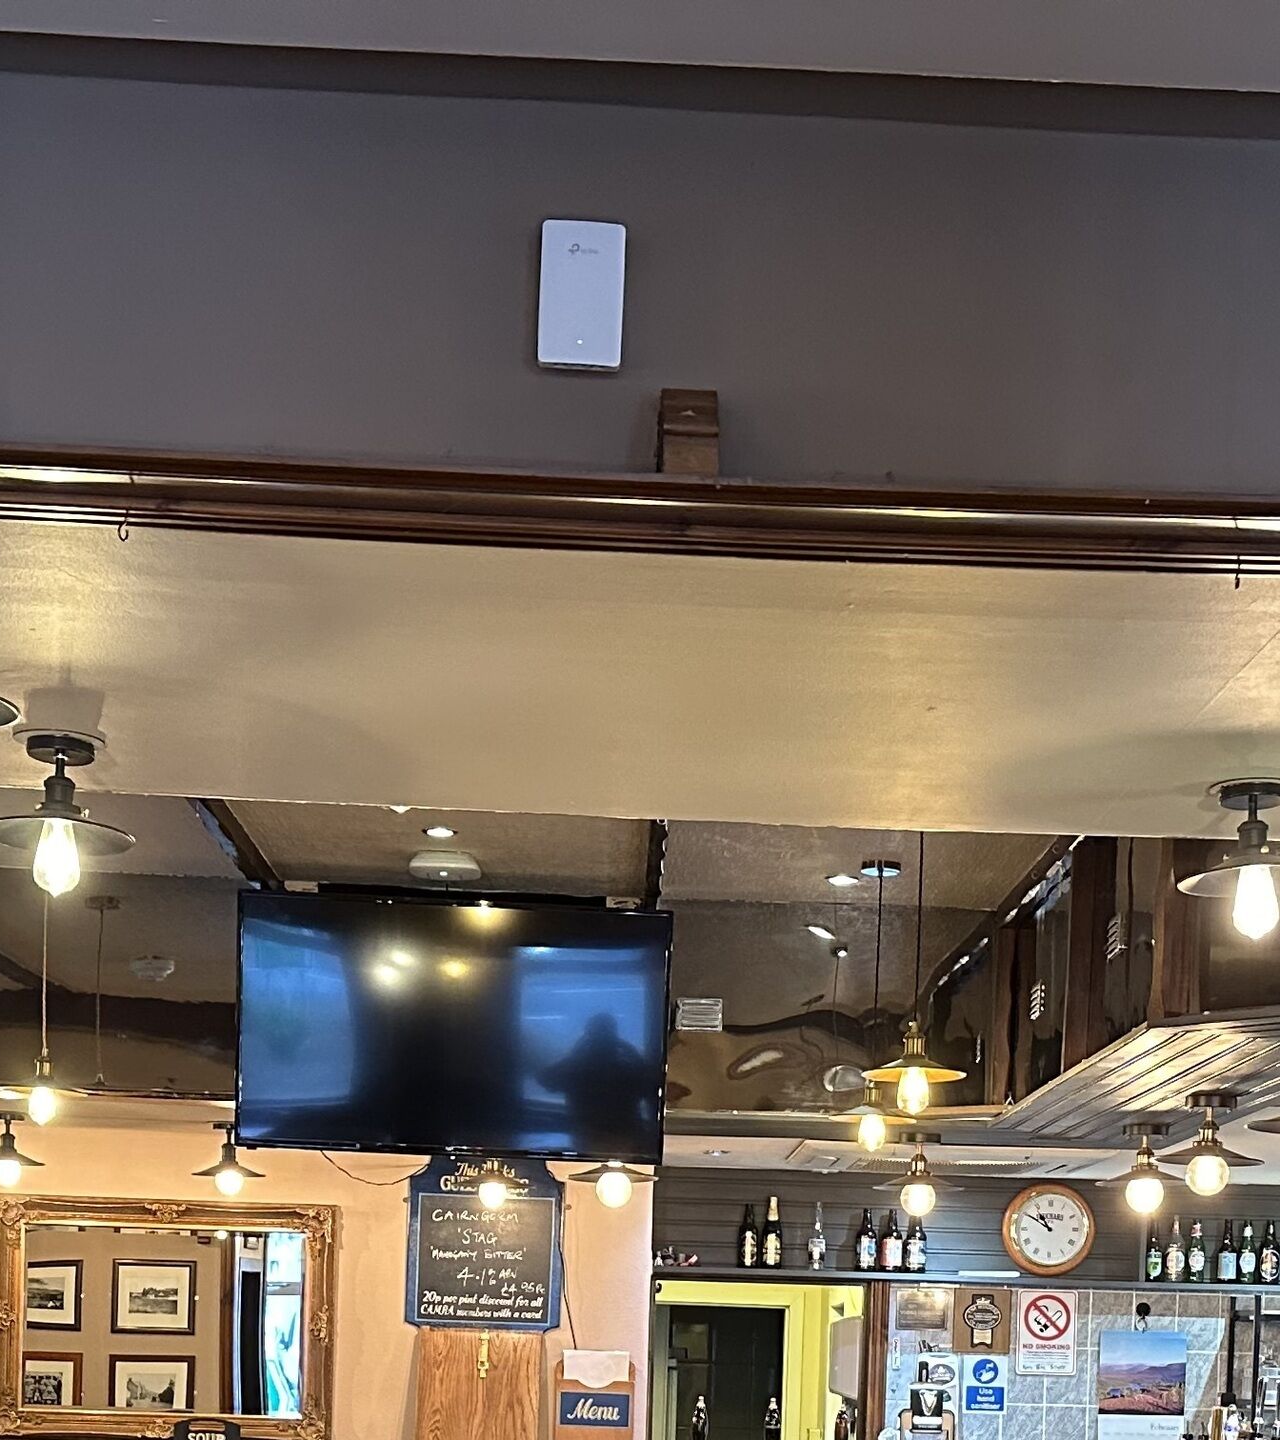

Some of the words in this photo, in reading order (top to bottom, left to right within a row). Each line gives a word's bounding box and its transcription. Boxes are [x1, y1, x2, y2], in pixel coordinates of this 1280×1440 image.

[432, 1208, 519, 1223] CAIRNGORM
[422, 1290, 442, 1304] 20p
[442, 1296, 458, 1305] per
[458, 1293, 478, 1306] pint
[478, 1293, 514, 1307] discount
[514, 1295, 529, 1308] for
[530, 1297, 544, 1307] all
[420, 1303, 455, 1316] CAMRA
[455, 1307, 492, 1318] members
[493, 1308, 512, 1319] with
[520, 1309, 543, 1319] card
[1035, 1343, 1071, 1351] SMOKING
[567, 1397, 620, 1421] Menu
